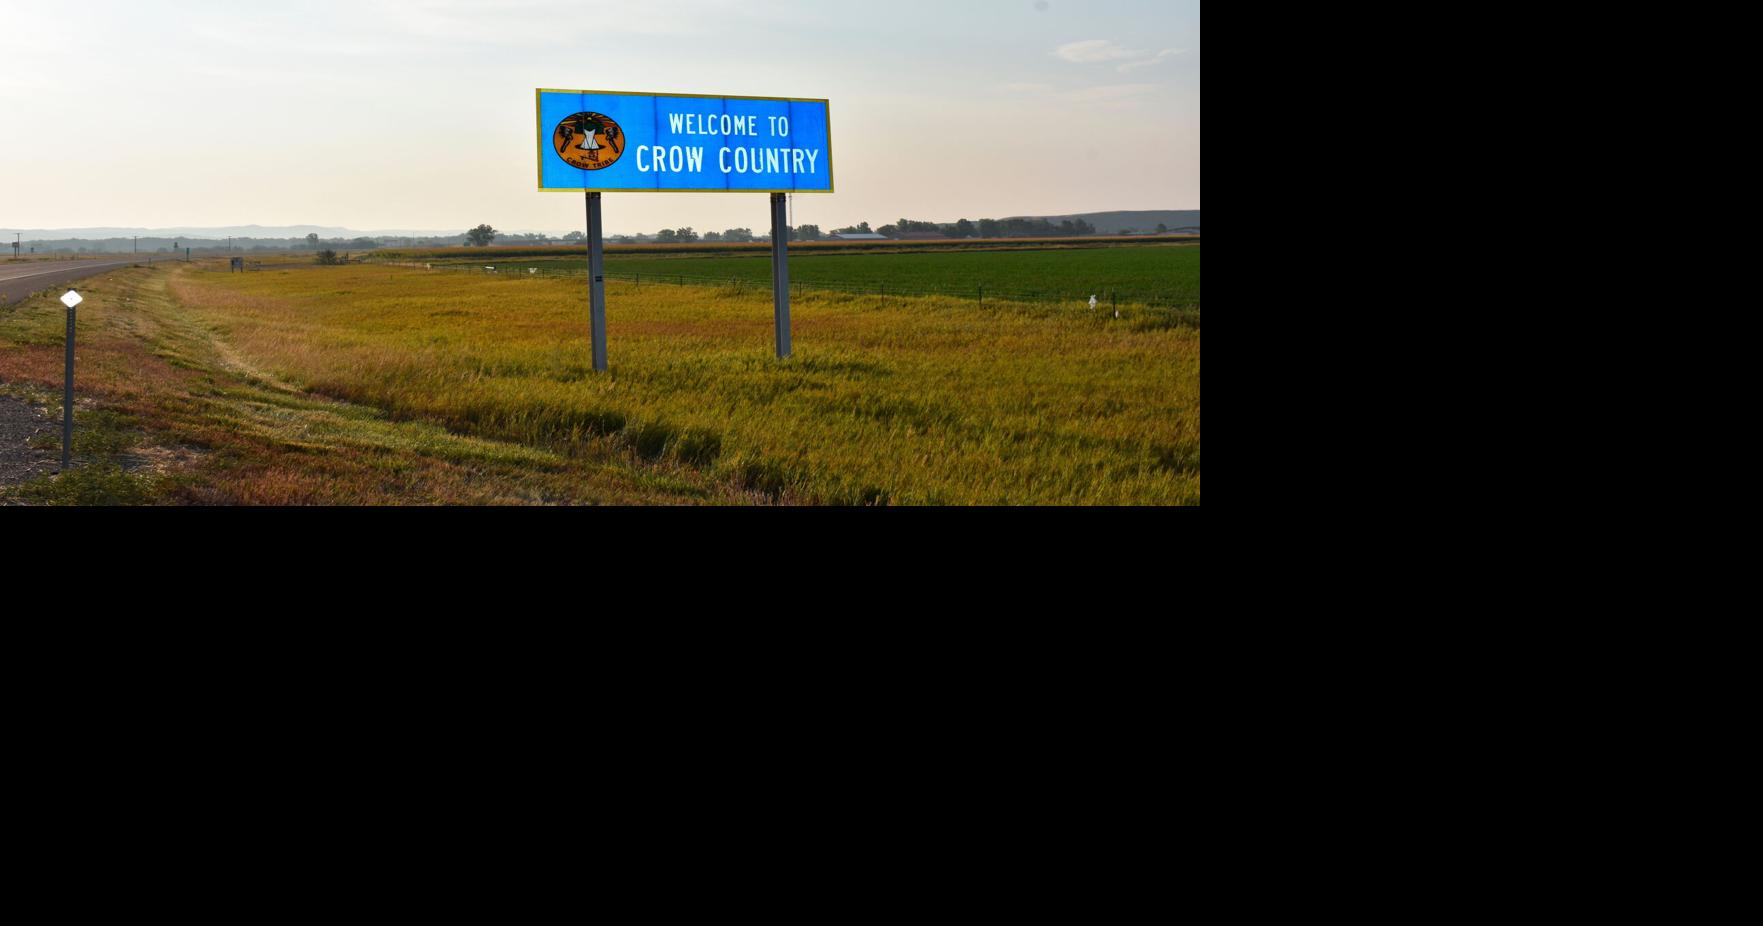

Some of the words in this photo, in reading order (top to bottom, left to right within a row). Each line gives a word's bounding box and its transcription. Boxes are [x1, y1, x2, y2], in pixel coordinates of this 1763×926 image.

[669, 112, 758, 136] WELCOME
[768, 115, 789, 137] TO
[566, 157, 589, 168] CROW
[636, 144, 704, 173] CROW
[719, 146, 819, 174] COUNTRY
